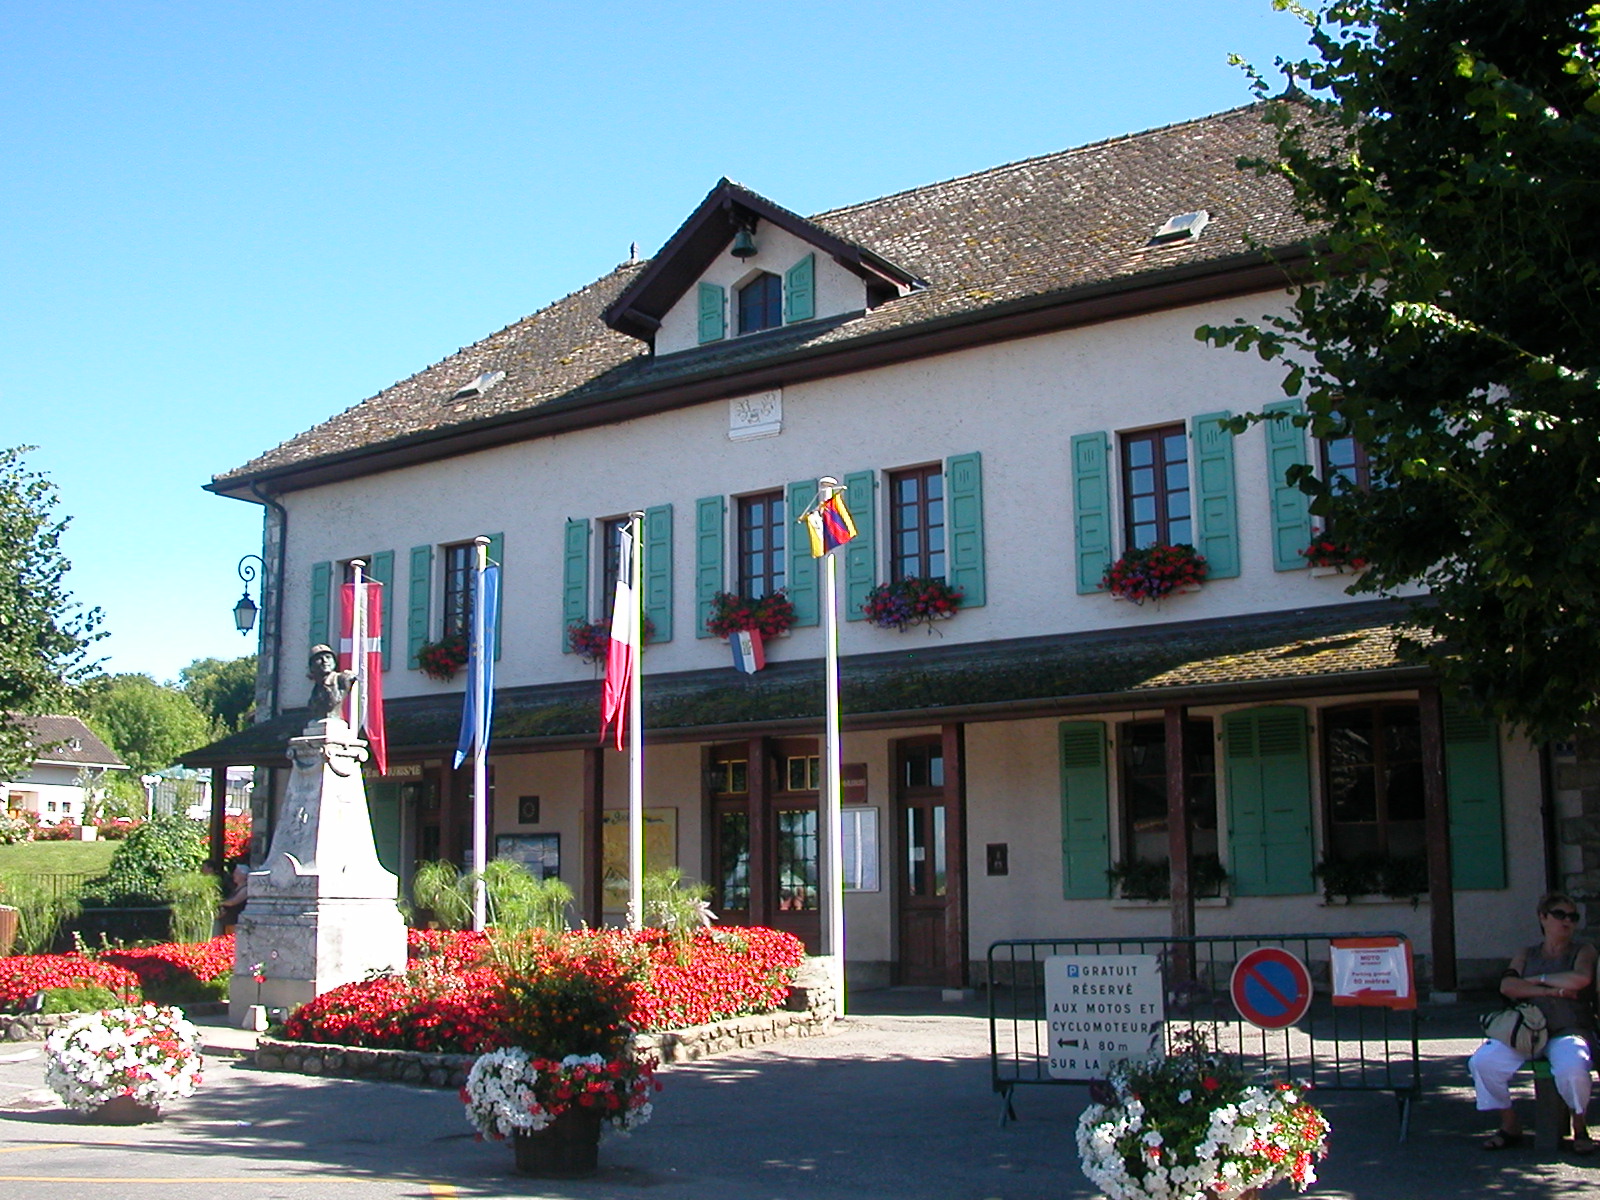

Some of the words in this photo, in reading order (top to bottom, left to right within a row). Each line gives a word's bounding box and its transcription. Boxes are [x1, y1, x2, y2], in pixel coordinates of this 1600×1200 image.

[1082, 966, 1138, 976] GRATUIT
[1072, 982, 1133, 995] RÉSERVÉ
[1053, 1003, 1078, 1013] AUX
[1086, 1003, 1131, 1013] MOTOS
[1140, 1003, 1155, 1014] ET
[1052, 1021, 1153, 1033] CYCLOMOTEUR
[1050, 1058, 1076, 1069] SUR
[1084, 1059, 1100, 1070] LA
